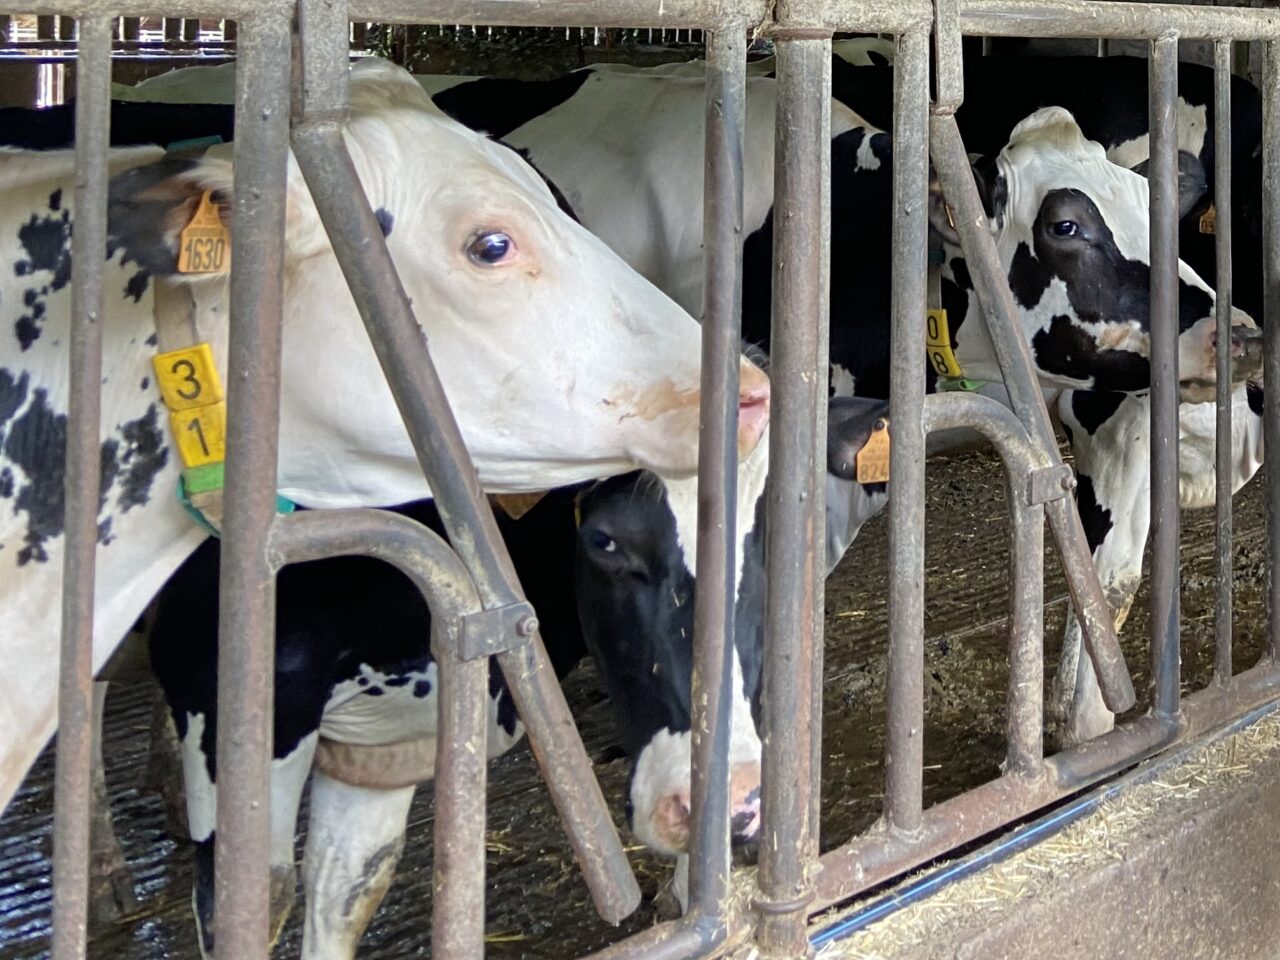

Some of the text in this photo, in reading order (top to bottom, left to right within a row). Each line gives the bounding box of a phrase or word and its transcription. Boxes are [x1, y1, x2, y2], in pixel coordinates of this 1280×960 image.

[185, 238, 225, 270] 1630
[171, 359, 202, 400] 3
[933, 351, 949, 375] 8
[187, 418, 210, 457] 1
